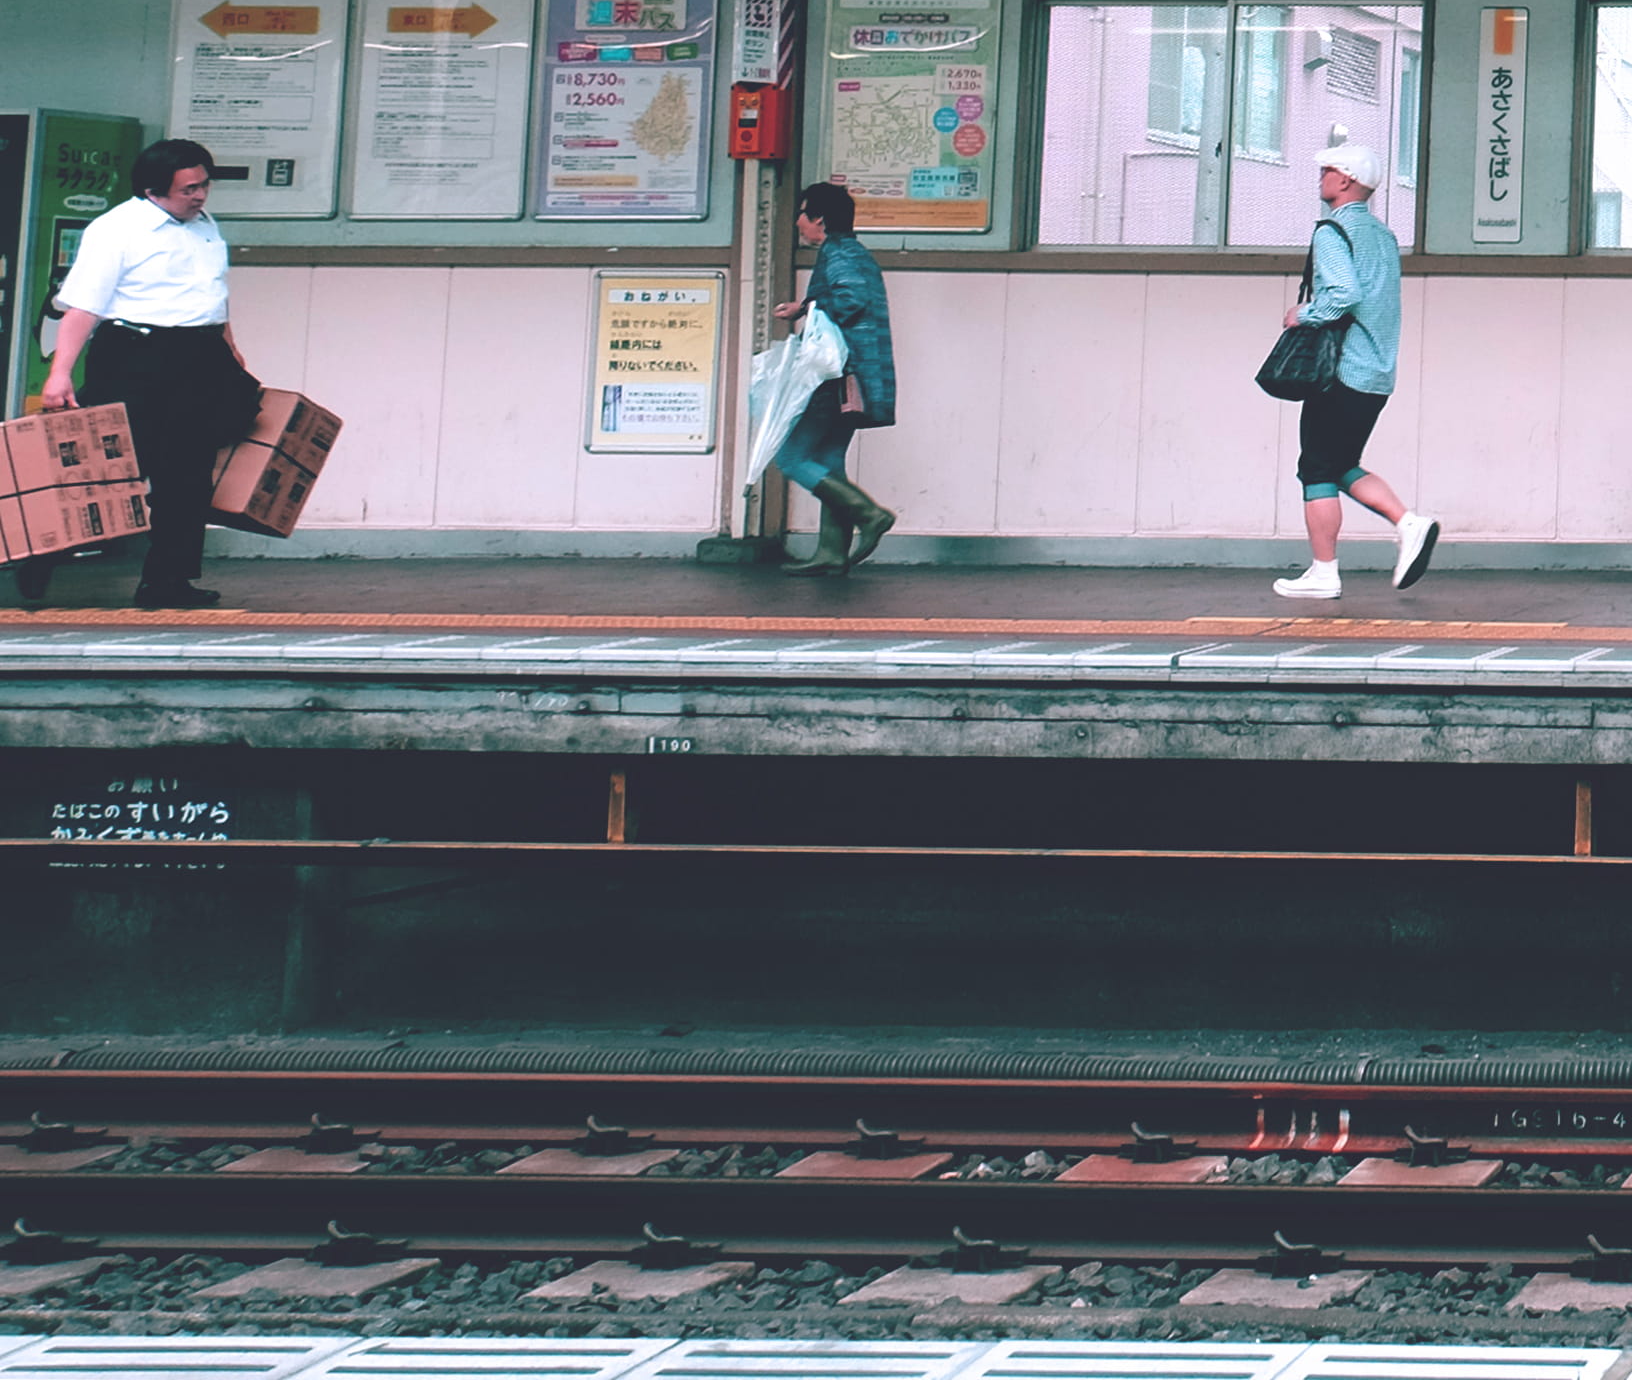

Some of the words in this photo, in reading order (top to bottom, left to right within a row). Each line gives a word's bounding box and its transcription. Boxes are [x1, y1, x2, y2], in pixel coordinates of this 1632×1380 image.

[853, 28, 972, 47] 休日おでかけパス
[574, 73, 626, 88] 8,730円
[573, 93, 625, 107] 2,560円
[1489, 66, 1514, 202] あさくさばし
[659, 738, 692, 752] 190
[51, 801, 229, 824] たばこのすいがら
